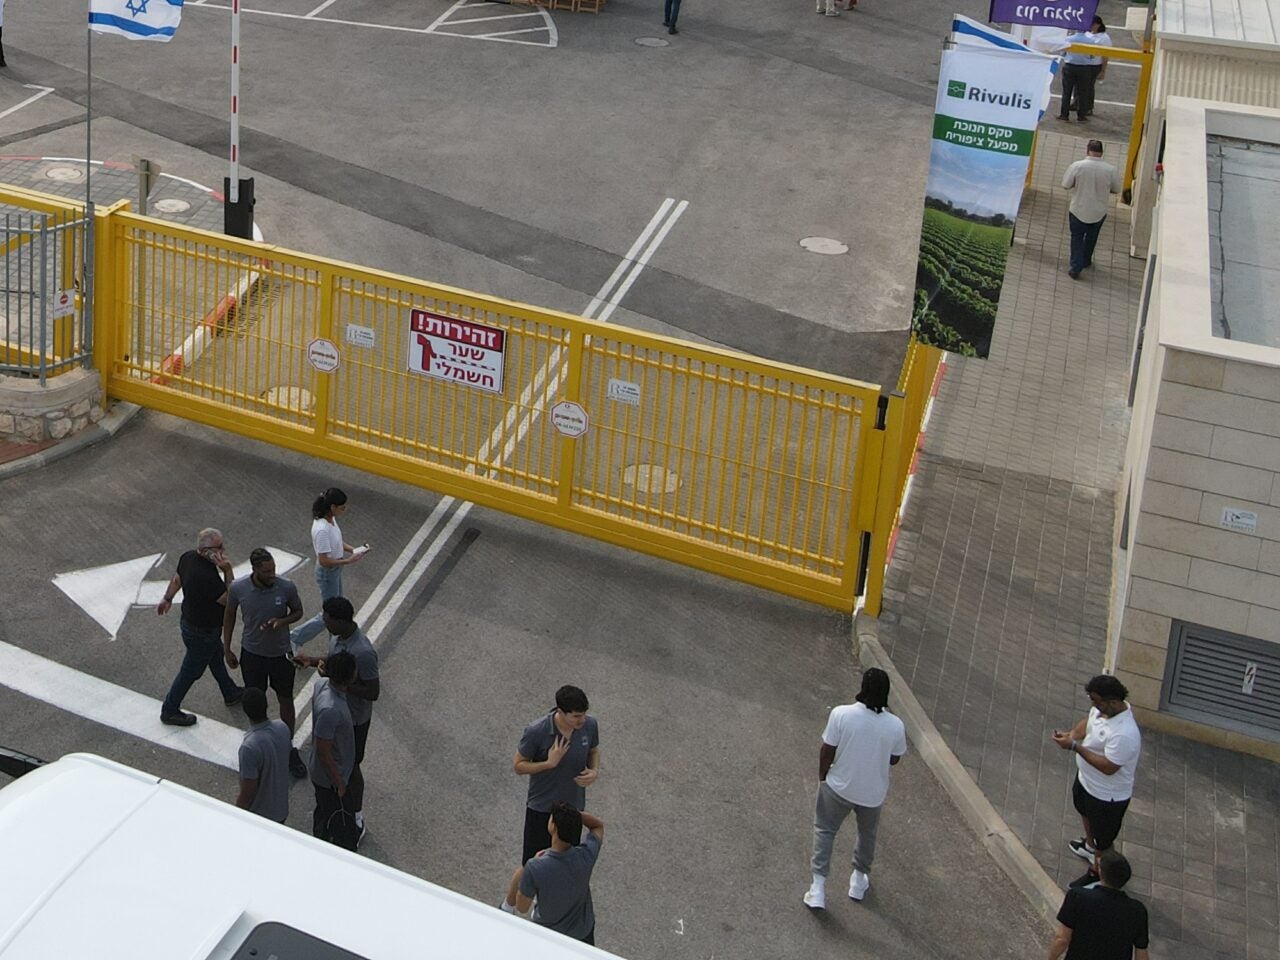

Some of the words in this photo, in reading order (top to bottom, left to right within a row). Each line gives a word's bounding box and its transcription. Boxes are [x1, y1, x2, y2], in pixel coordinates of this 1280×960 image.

[968, 87, 1032, 110] Rivulis
[953, 121, 985, 133] חנוכת
[987, 128, 1013, 139] טקס
[945, 131, 984, 146] ציפורית
[987, 138, 1018, 152] מפעל
[418, 313, 496, 347] זהירות!
[448, 342, 485, 361] שער
[435, 361, 494, 387] חשמלי
